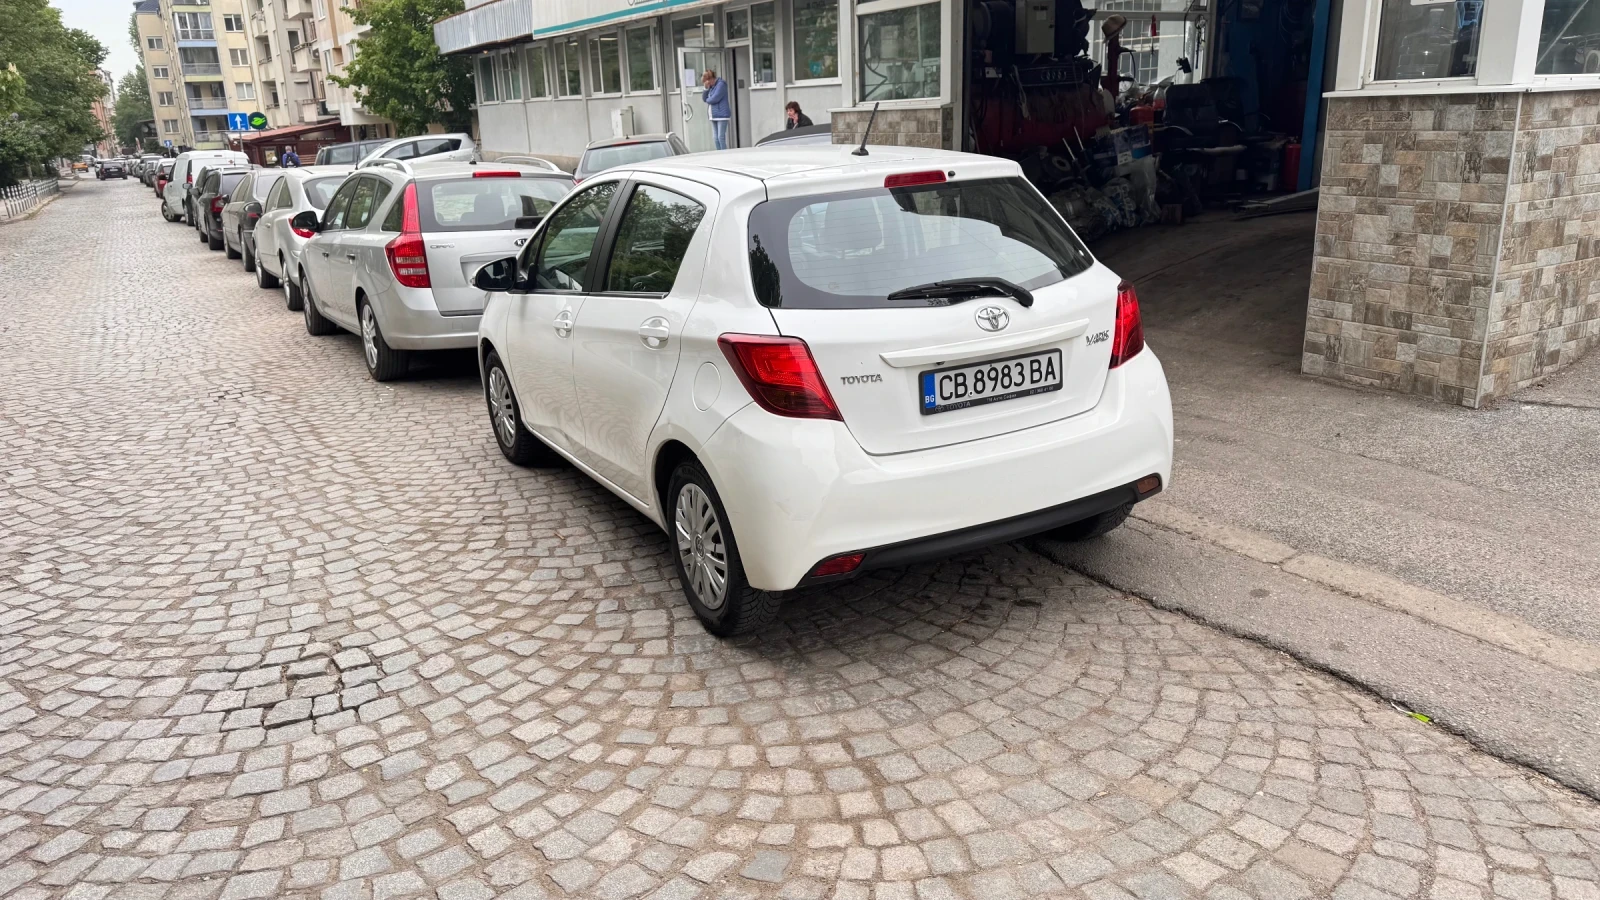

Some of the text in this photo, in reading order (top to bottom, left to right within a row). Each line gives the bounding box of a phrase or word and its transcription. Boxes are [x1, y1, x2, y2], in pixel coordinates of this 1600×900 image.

[840, 374, 883, 385] TOYOTA
[925, 395, 935, 404] BG
[946, 401, 971, 410] TOYOTA
